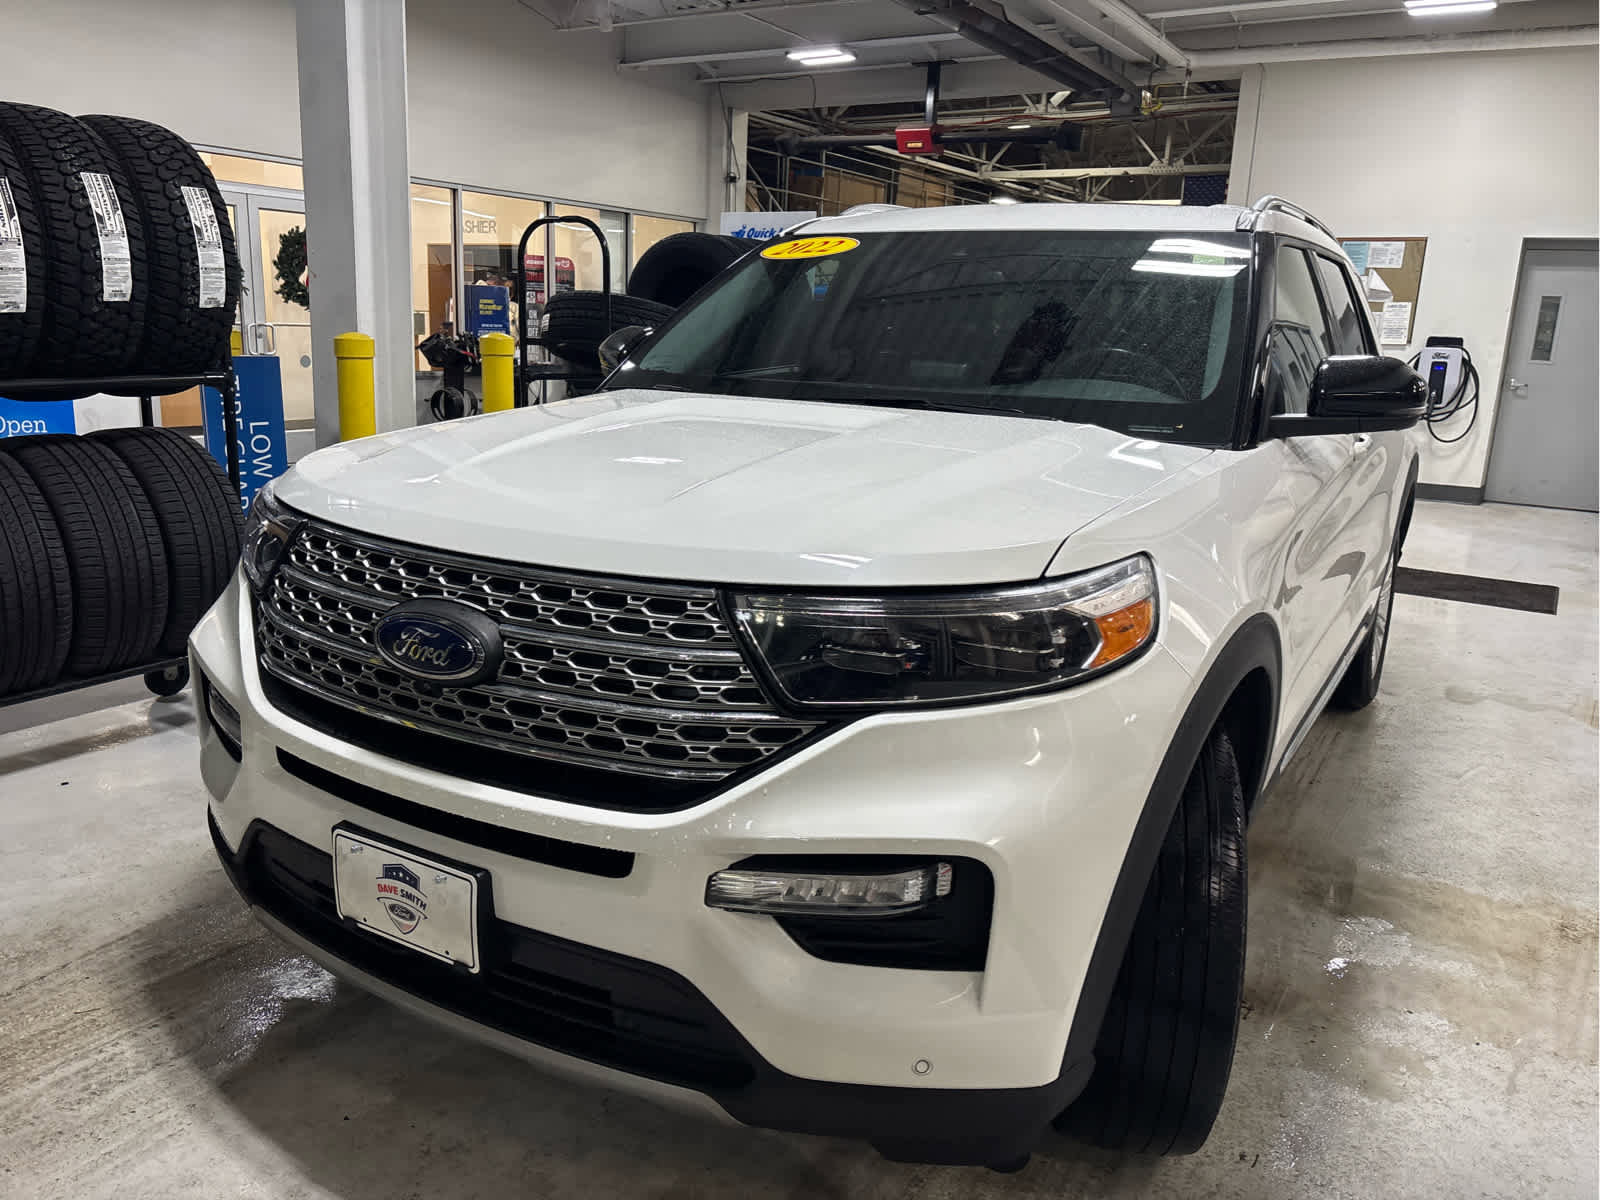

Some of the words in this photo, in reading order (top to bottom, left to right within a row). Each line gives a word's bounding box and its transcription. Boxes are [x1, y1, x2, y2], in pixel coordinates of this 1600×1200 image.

[463, 220, 497, 234] SHIER
[747, 226, 777, 239] Quick
[771, 240, 845, 256] 2022
[249, 421, 274, 478] LOW
[393, 626, 455, 667] Ford
[377, 883, 399, 896] DAVE
[399, 888, 427, 911] SMITH
